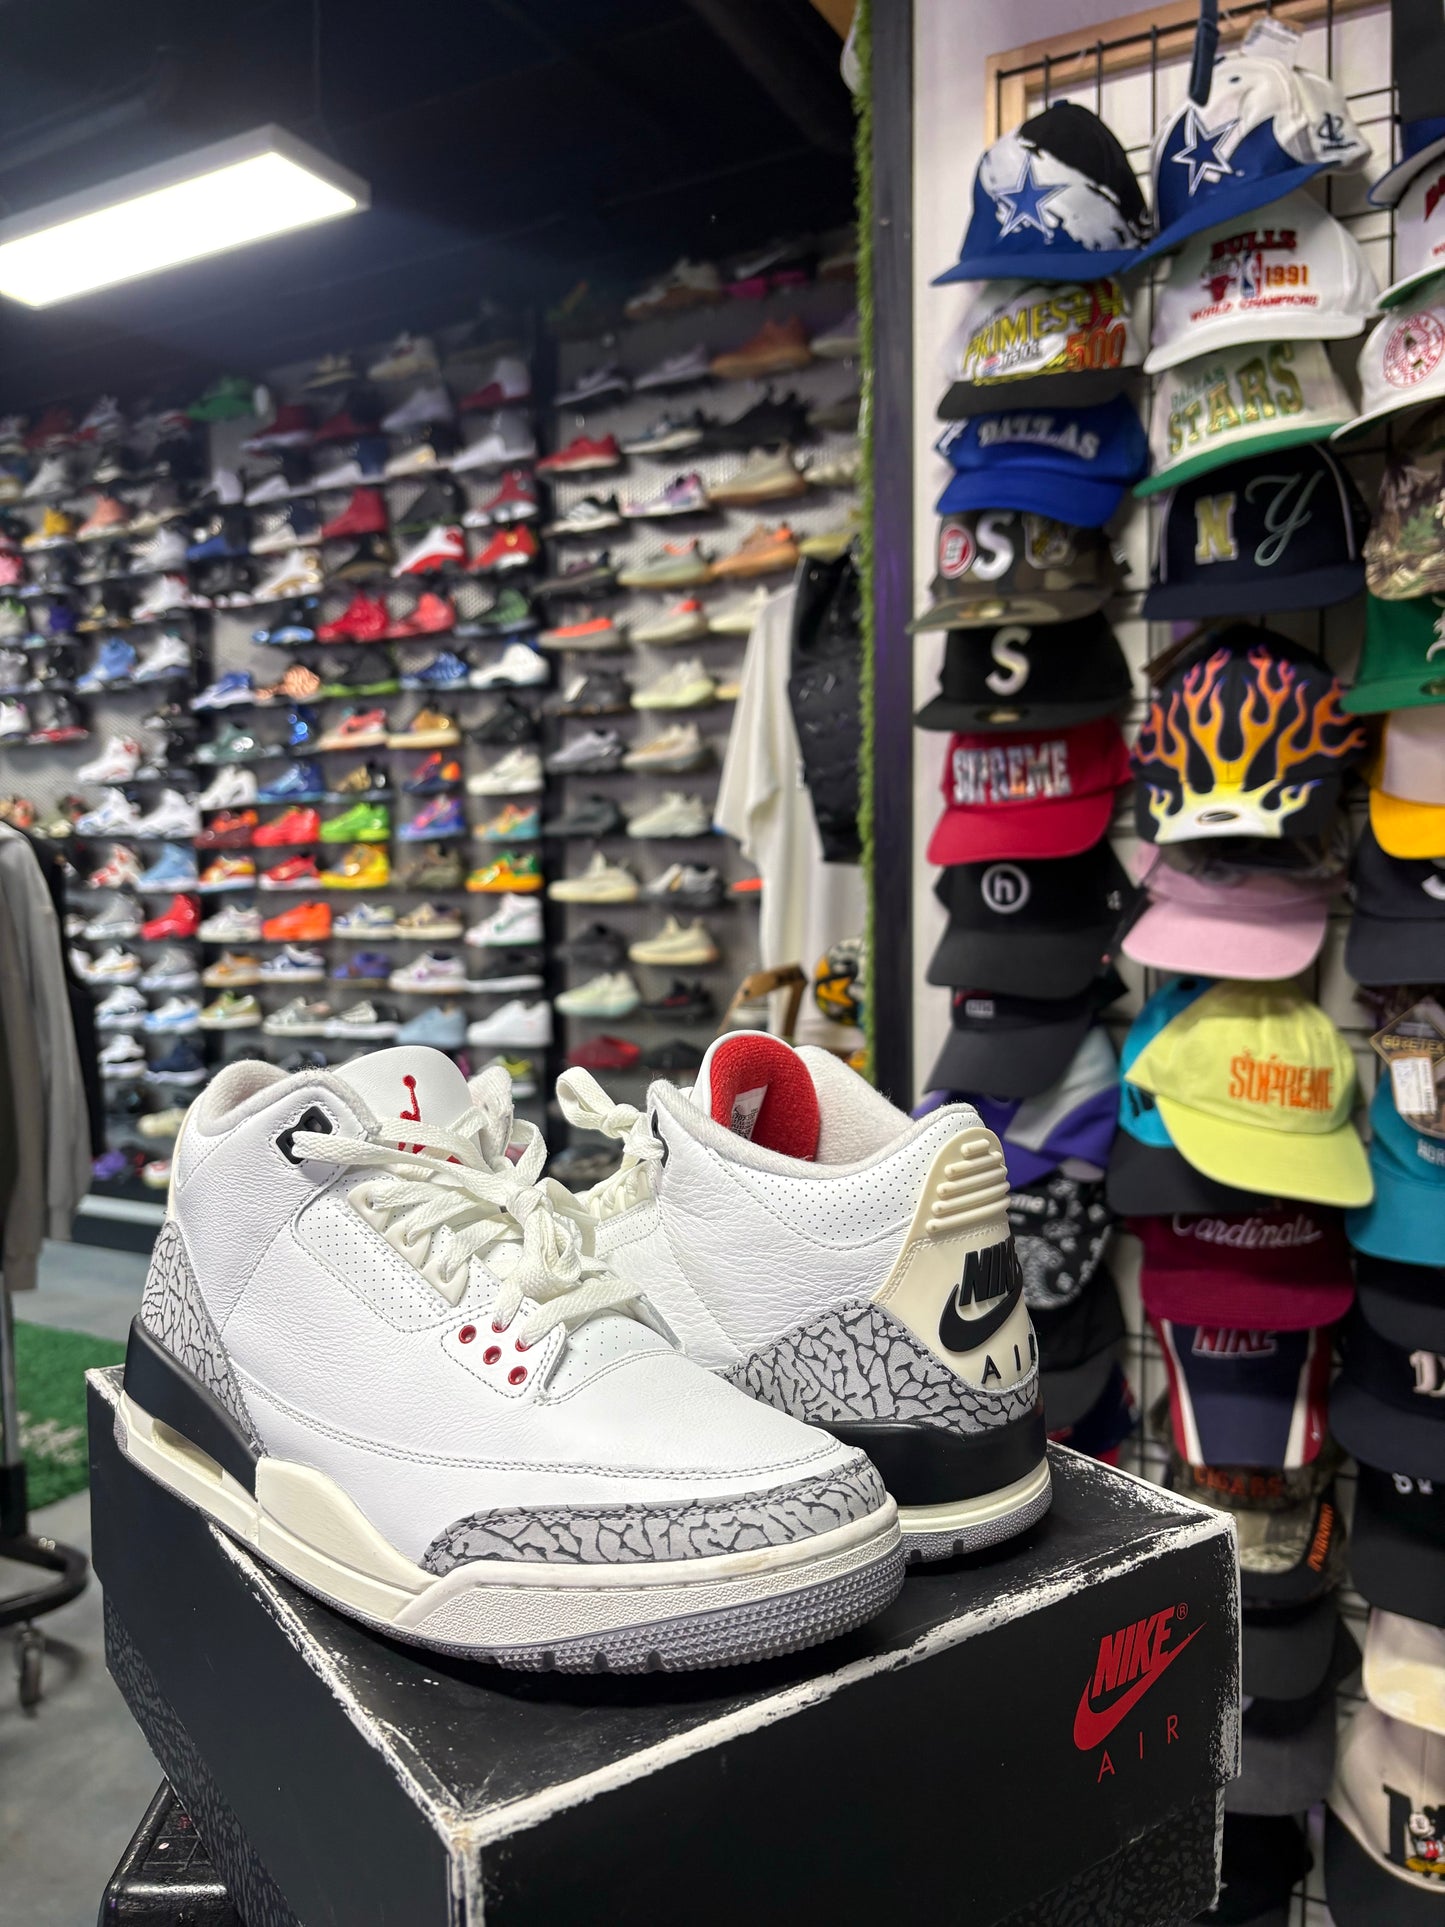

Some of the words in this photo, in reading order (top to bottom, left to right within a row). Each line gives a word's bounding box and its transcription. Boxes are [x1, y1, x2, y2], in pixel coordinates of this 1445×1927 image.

[1211, 230, 1296, 260] BULLS
[1266, 264, 1308, 286] 1991
[1190, 302, 1231, 321] WORLD
[1240, 295, 1317, 310] CHAMPIONS
[1066, 323, 1126, 370] 500
[1169, 342, 1304, 454] STARS
[977, 416, 1099, 460] DALLAS
[971, 513, 1014, 580] S
[1194, 491, 1239, 565] N
[985, 626, 1032, 696] S
[953, 741, 1072, 804] SUPREME
[993, 872, 1015, 901] h
[1172, 1203, 1323, 1249] Cardinals
[1091, 1606, 1175, 1699] NIKE
[1097, 1714, 1180, 1783] AIR
